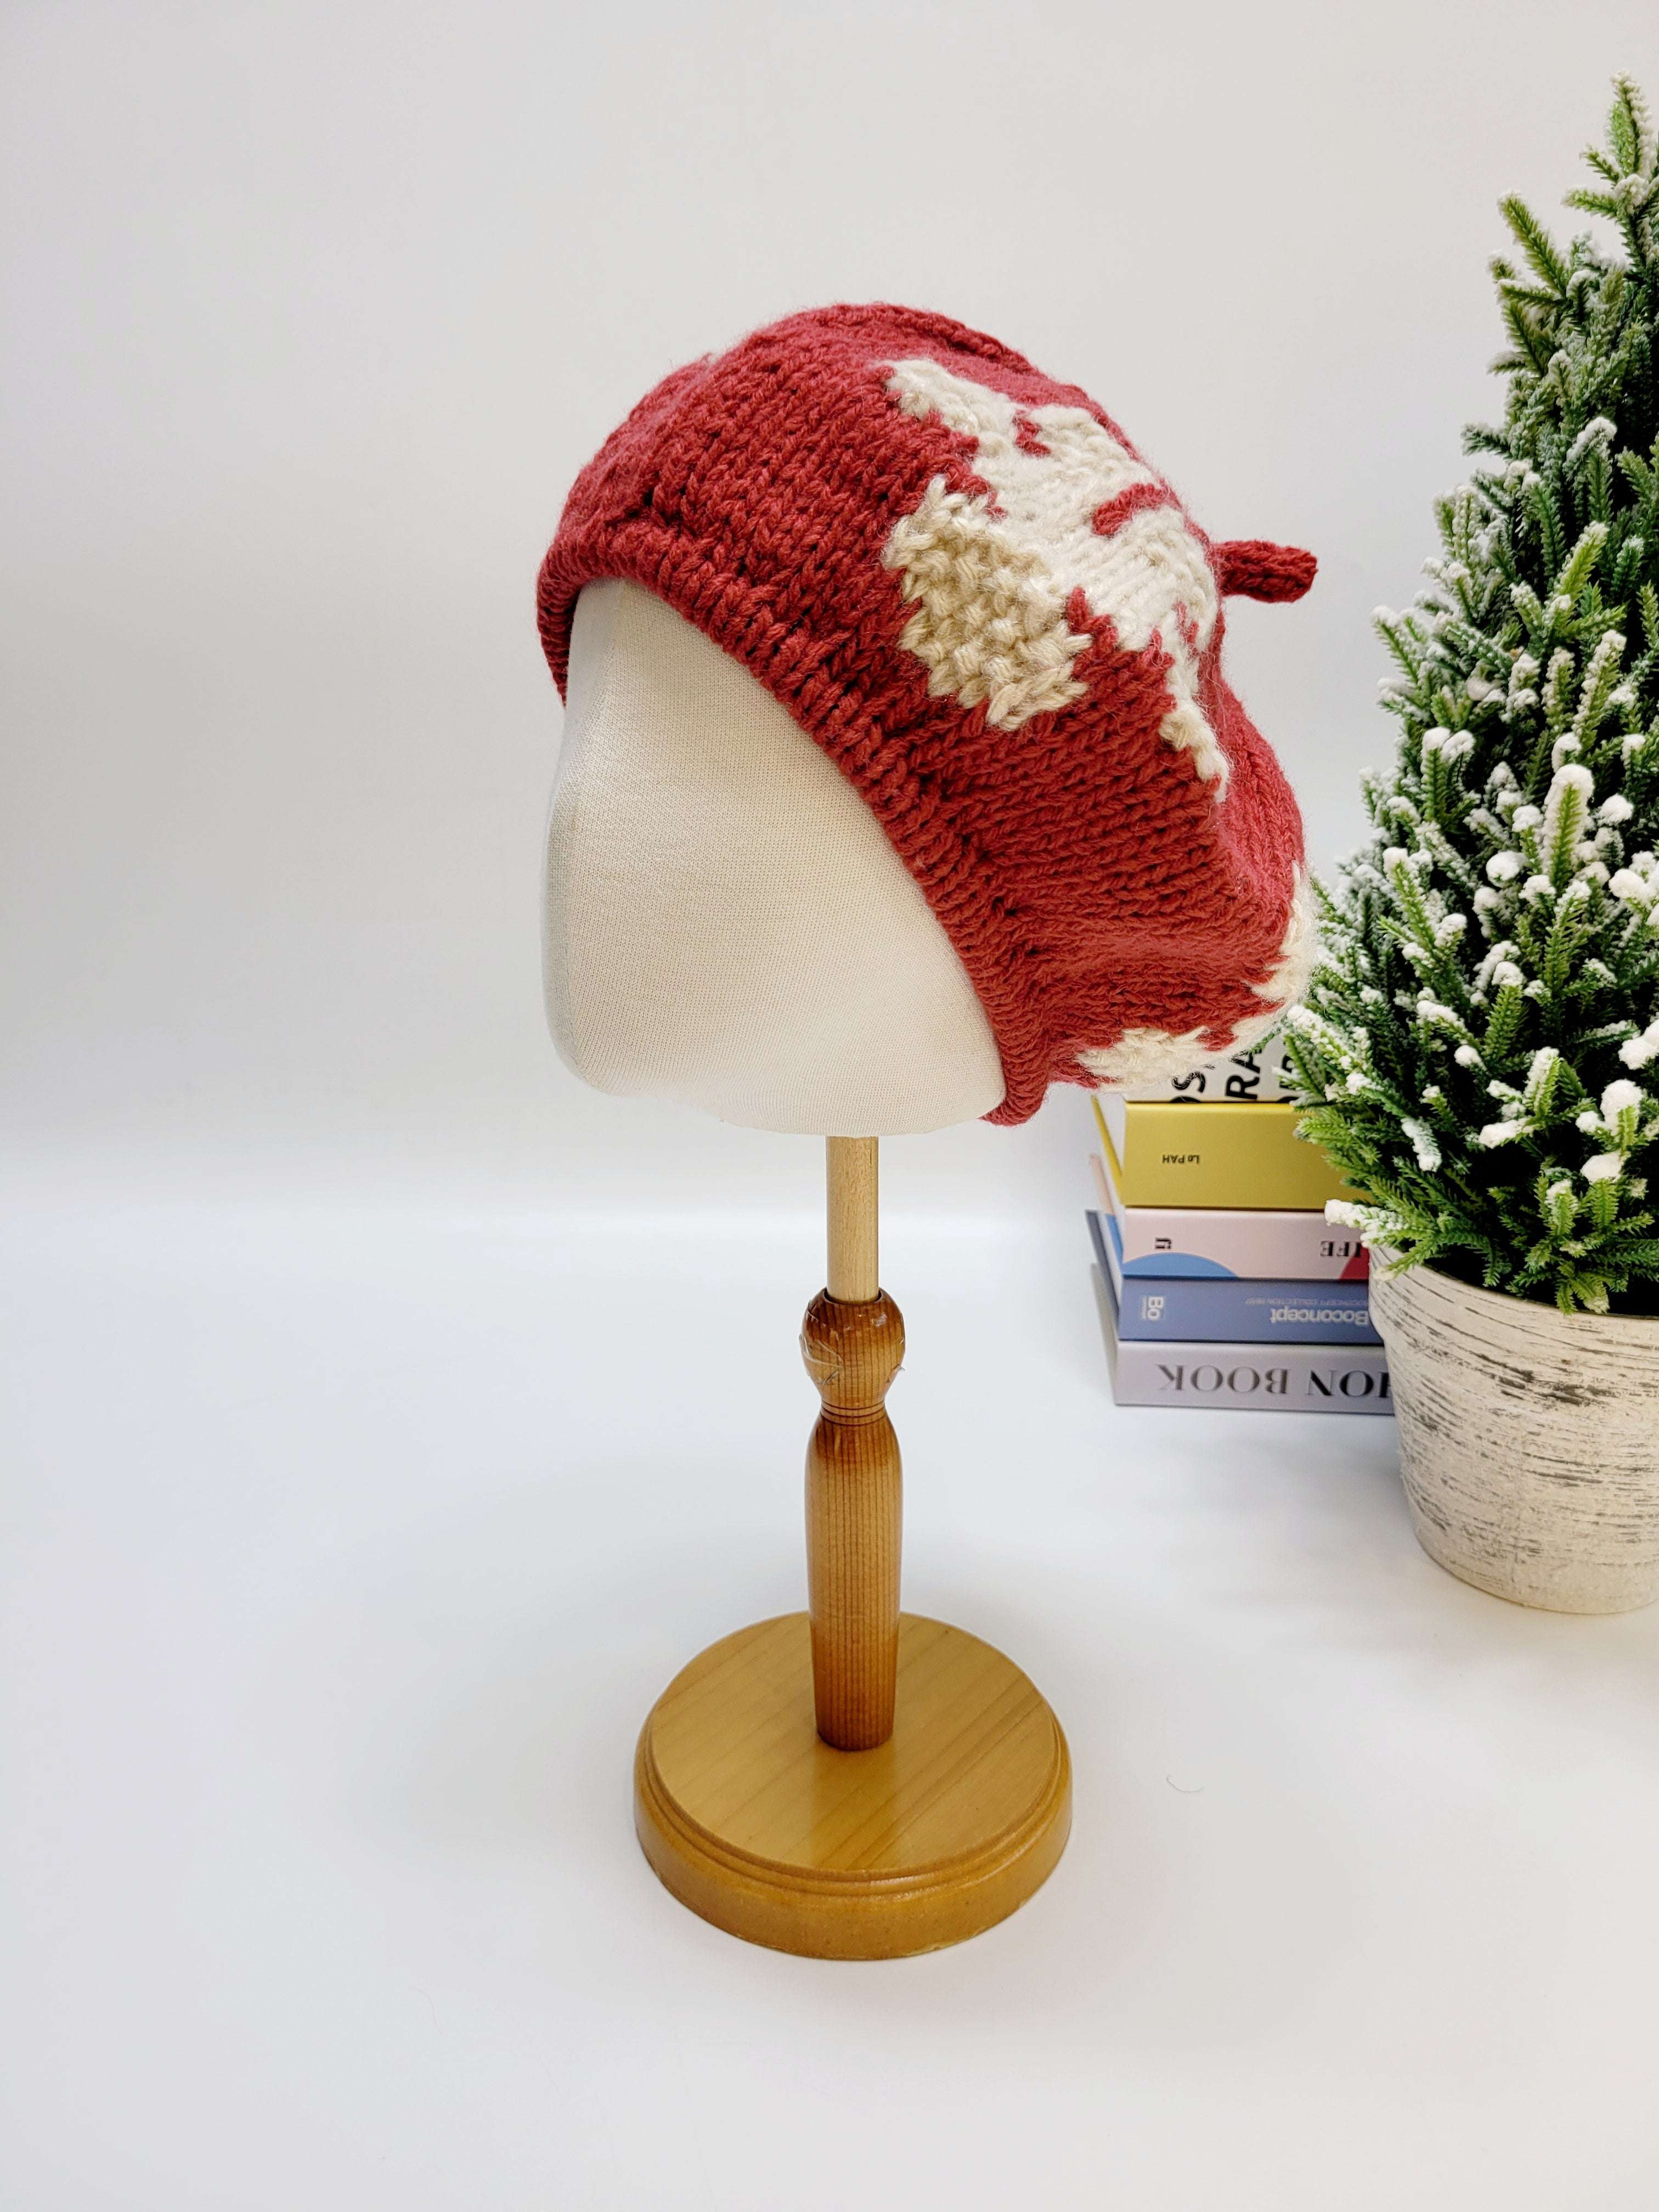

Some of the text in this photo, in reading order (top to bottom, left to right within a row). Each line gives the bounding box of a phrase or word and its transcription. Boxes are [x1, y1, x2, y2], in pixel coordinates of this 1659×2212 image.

[1162, 1154, 1185, 1164] PAH
[1270, 1306, 1369, 1325] Boconcept
[1156, 1364, 1290, 1395] BOOK
